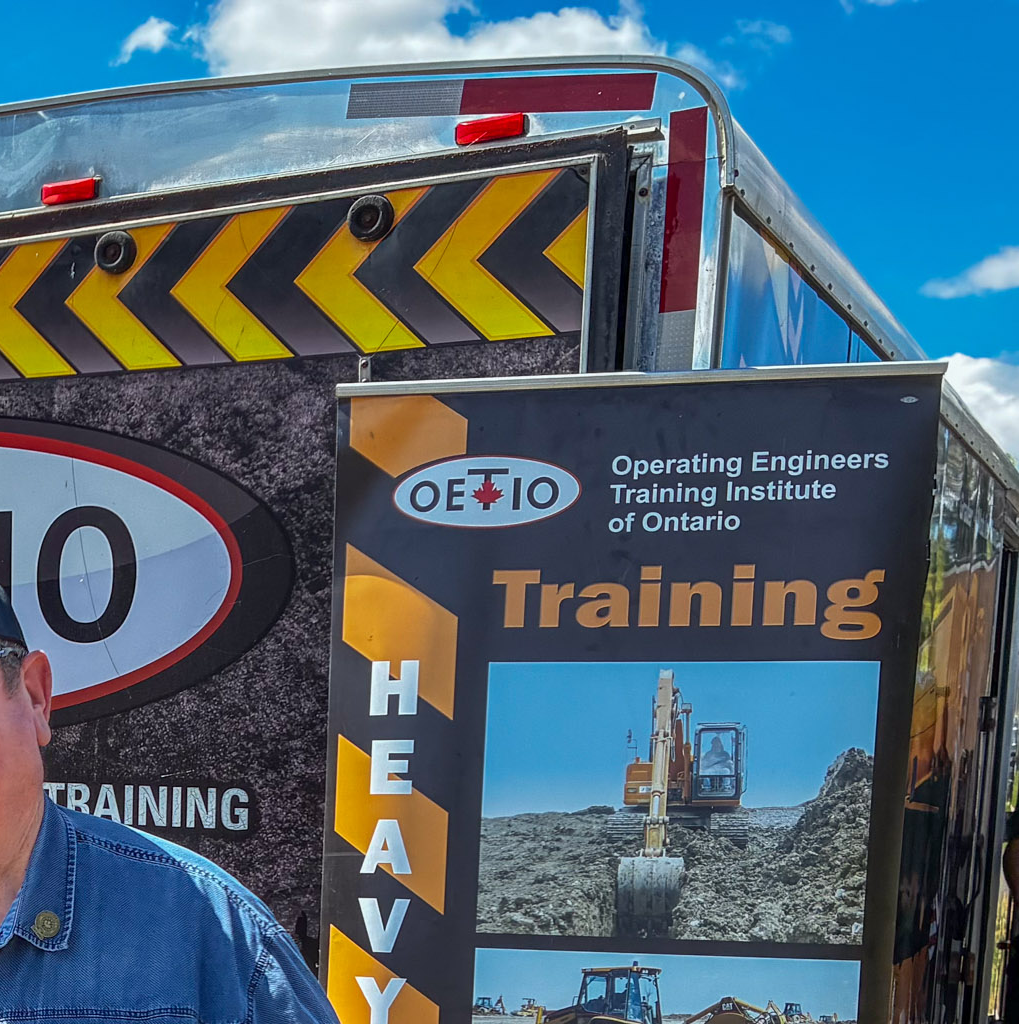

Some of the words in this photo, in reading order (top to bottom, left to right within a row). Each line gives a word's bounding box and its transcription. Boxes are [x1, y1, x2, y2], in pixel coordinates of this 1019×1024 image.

[611, 453, 743, 479] Operating
[752, 450, 889, 476] Engineers
[410, 468, 560, 512] OETIO
[609, 482, 717, 507] Training
[726, 480, 837, 501] Institute
[608, 512, 635, 532] of
[642, 511, 741, 532] Ontario
[492, 564, 886, 640] Training
[43, 782, 249, 831] TRAINING
